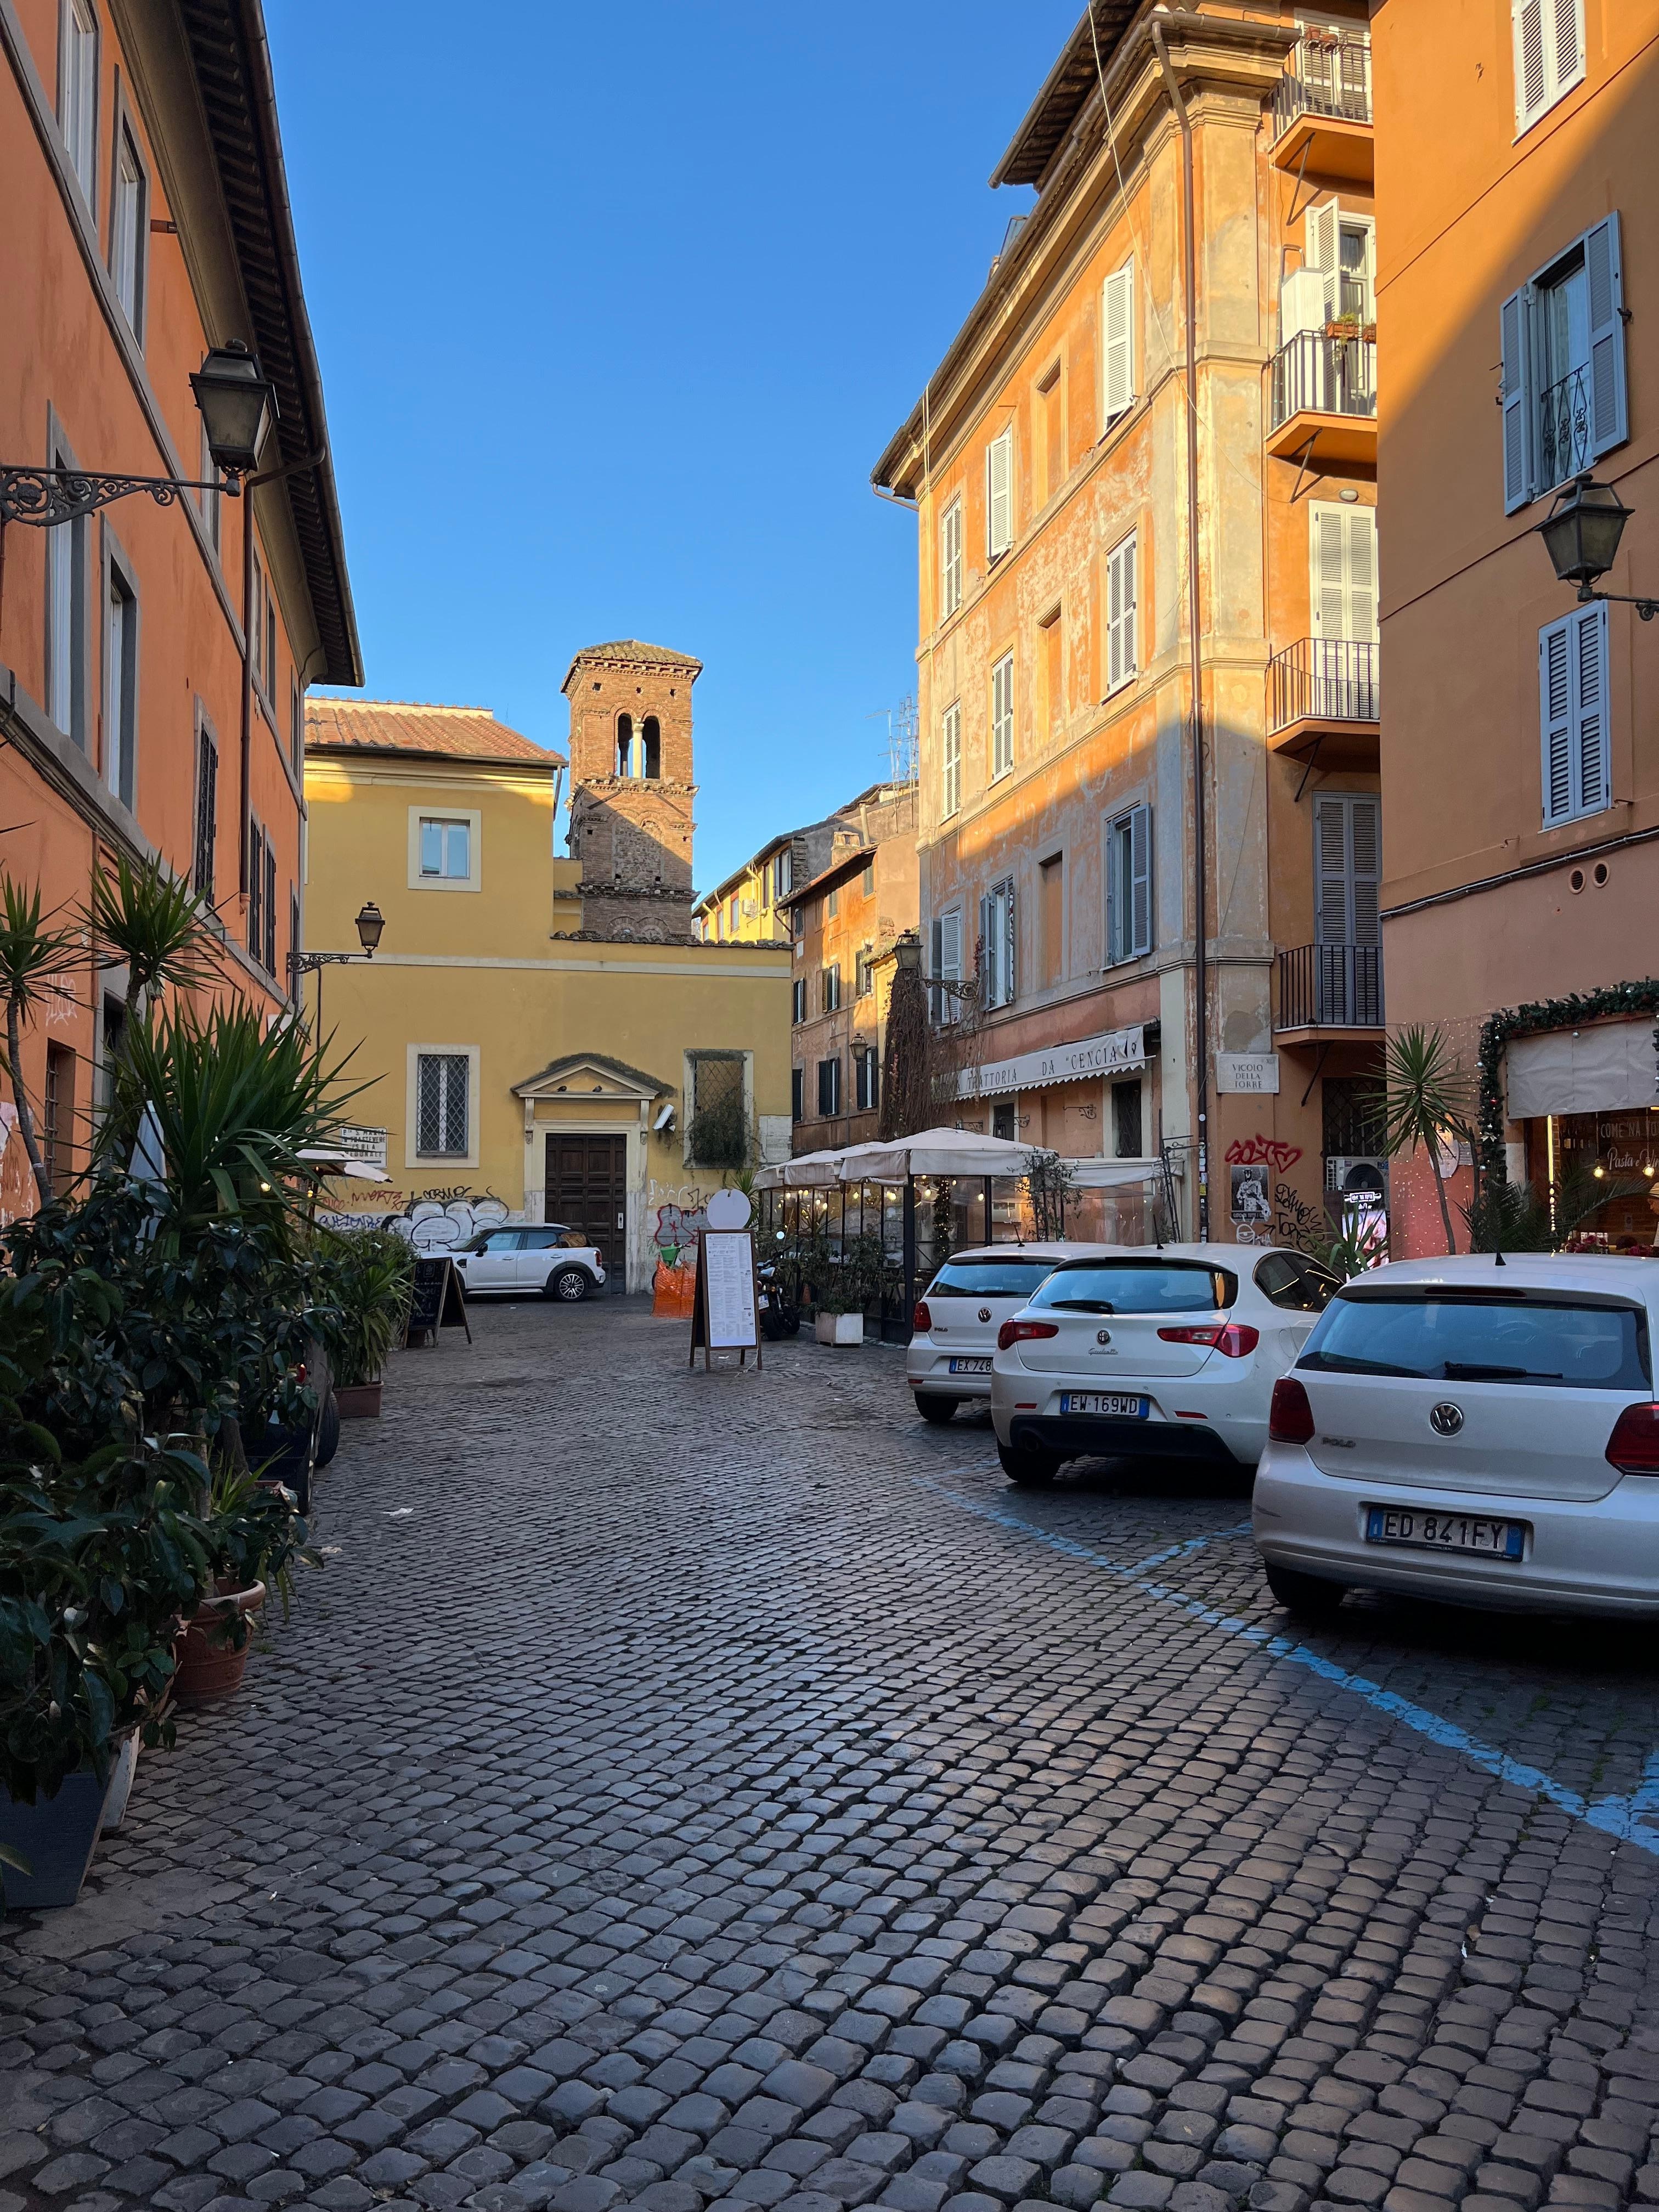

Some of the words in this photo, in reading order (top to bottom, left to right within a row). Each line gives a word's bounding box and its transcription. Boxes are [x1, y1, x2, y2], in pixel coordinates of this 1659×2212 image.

[1042, 1060, 1054, 1076] DA
[1600, 1124, 1624, 1138] COME
[1607, 1147, 1633, 1170] Pasta
[957, 1360, 969, 1371] EX
[1070, 1395, 1087, 1411] EW
[1094, 1397, 1137, 1414] 169WD
[1385, 1513, 1414, 1538] ED
[1424, 1516, 1504, 1549] 841FY
